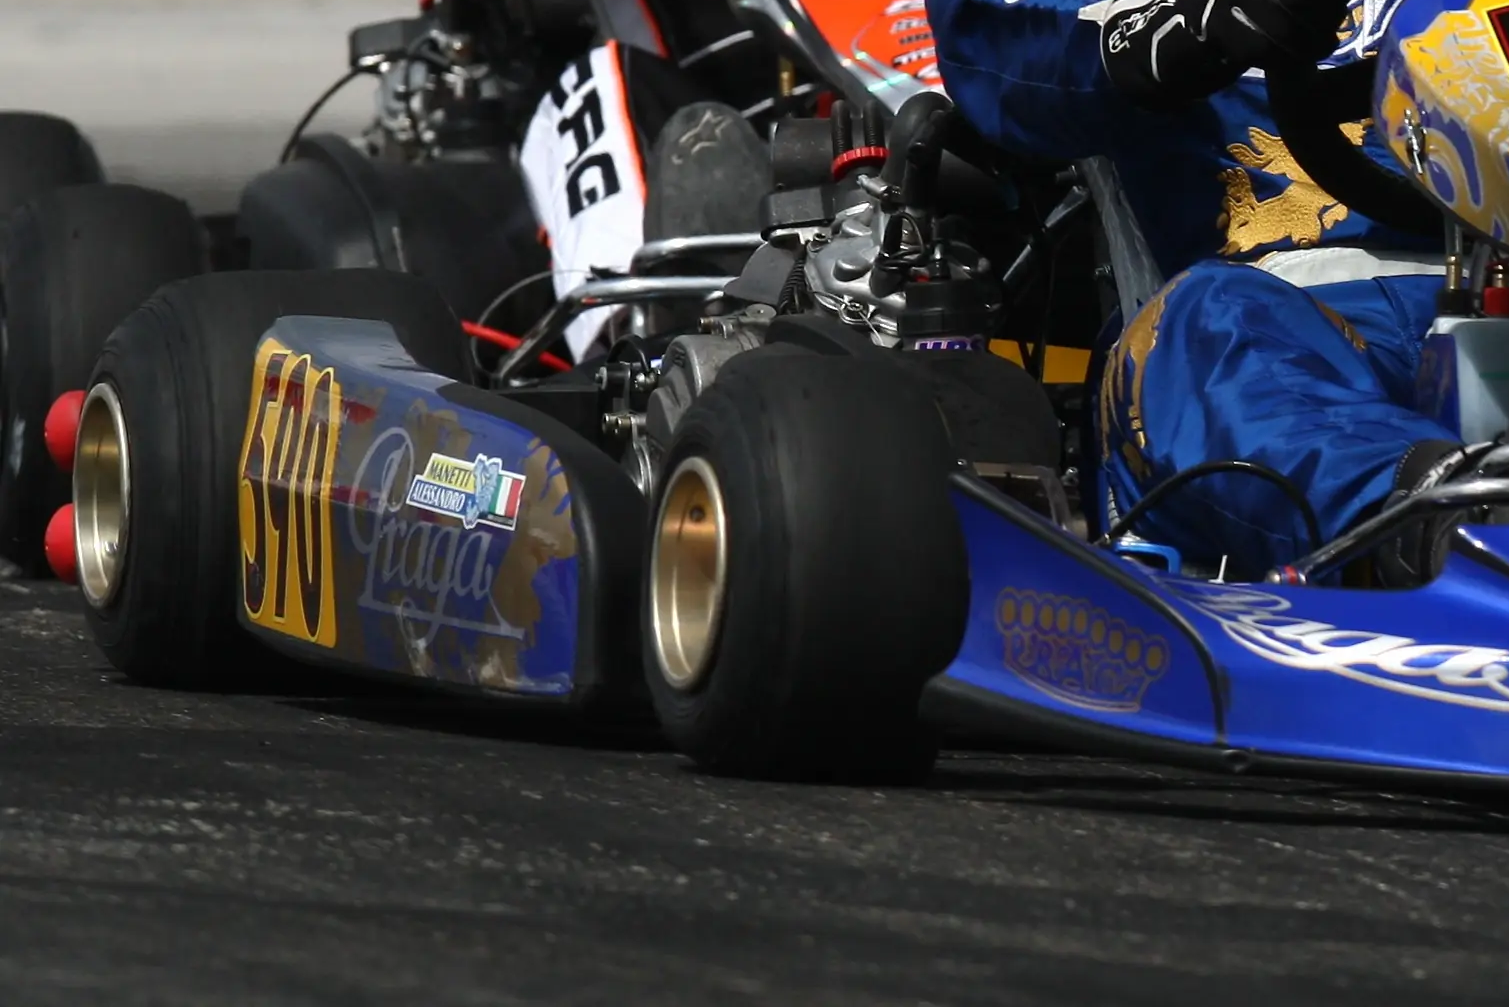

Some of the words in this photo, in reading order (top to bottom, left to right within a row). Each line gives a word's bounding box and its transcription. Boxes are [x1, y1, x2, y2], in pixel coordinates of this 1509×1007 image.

[241, 349, 335, 643] 590
[411, 481, 466, 513] ALESSANDRO
[430, 460, 472, 488] MANETTI
[349, 427, 525, 648] Praga
